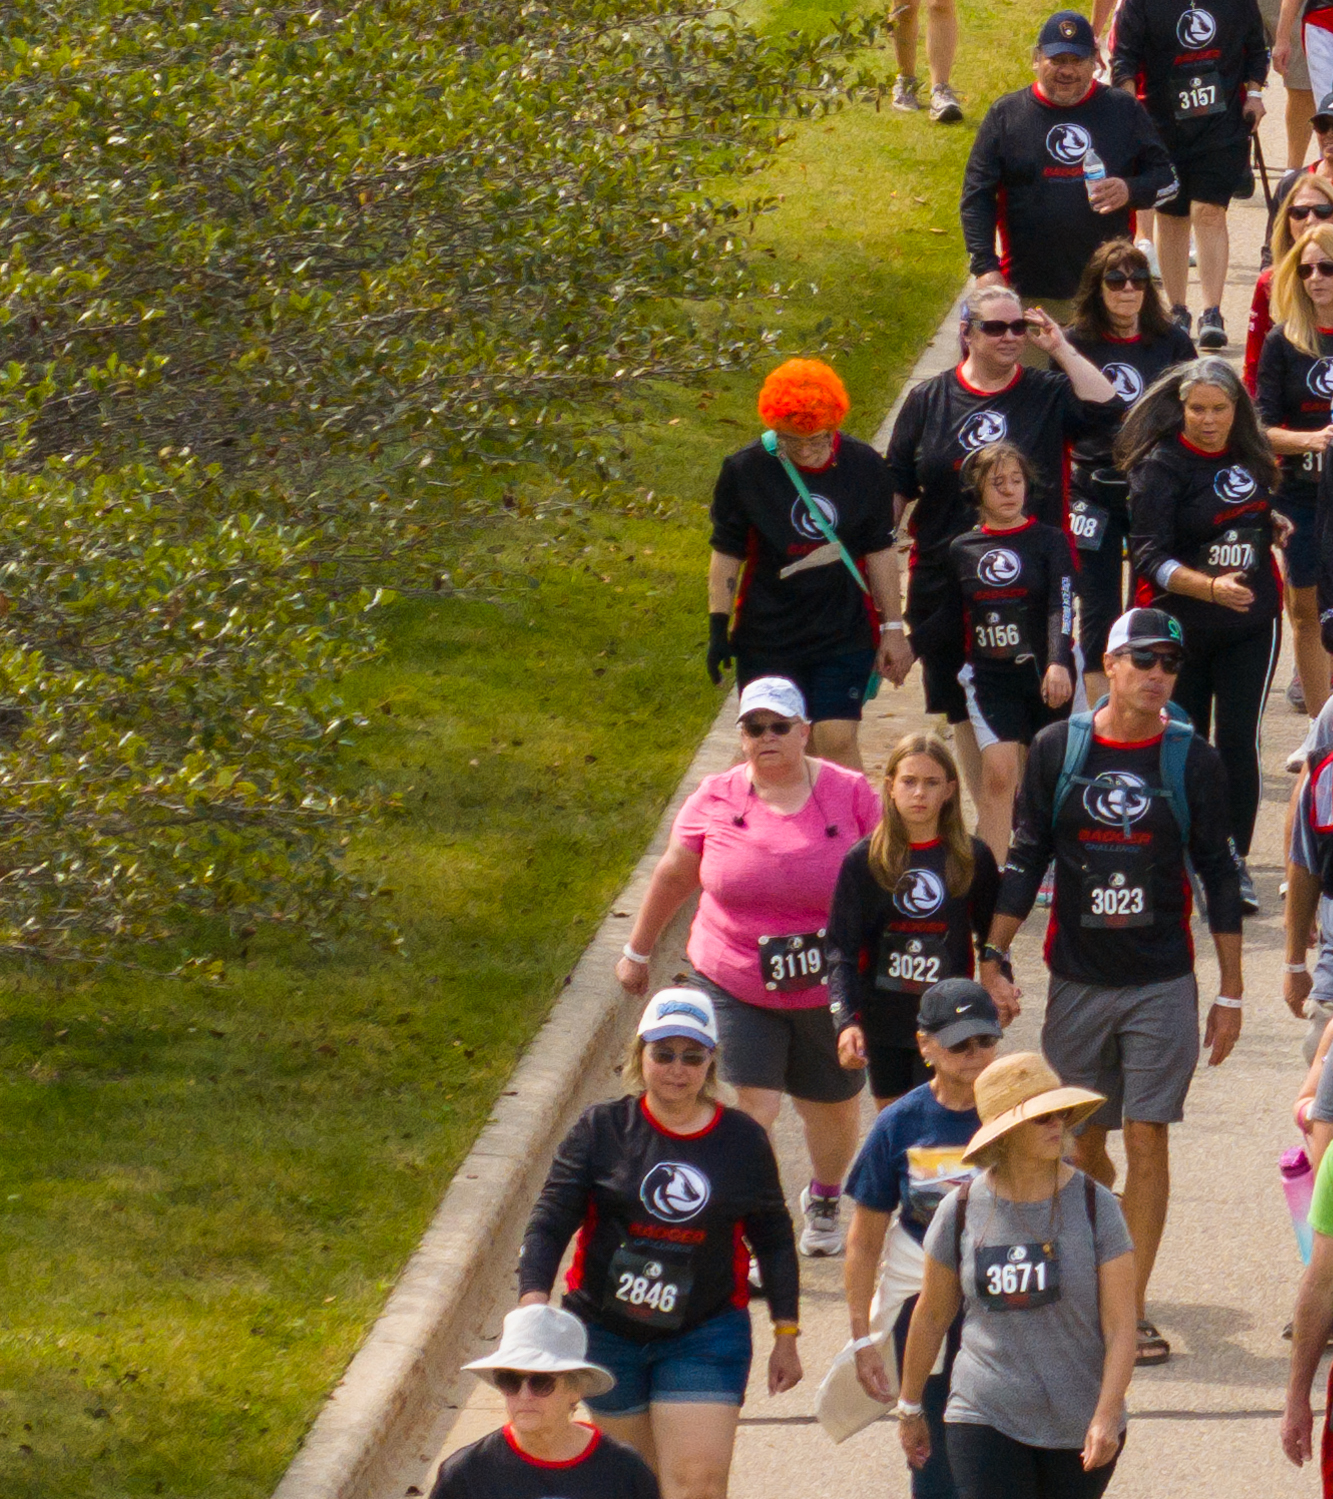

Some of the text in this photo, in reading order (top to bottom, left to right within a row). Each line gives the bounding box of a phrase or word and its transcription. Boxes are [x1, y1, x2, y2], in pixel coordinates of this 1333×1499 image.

[1178, 85, 1217, 110] 3157
[1302, 451, 1323, 472] 31
[1208, 543, 1252, 568] 3007
[975, 623, 1020, 648] 3156
[1091, 887, 1145, 914] 3023
[770, 948, 821, 981] 3119
[888, 952, 941, 984] 3022
[987, 1261, 1047, 1296] 3671
[615, 1272, 678, 1313] 2846
